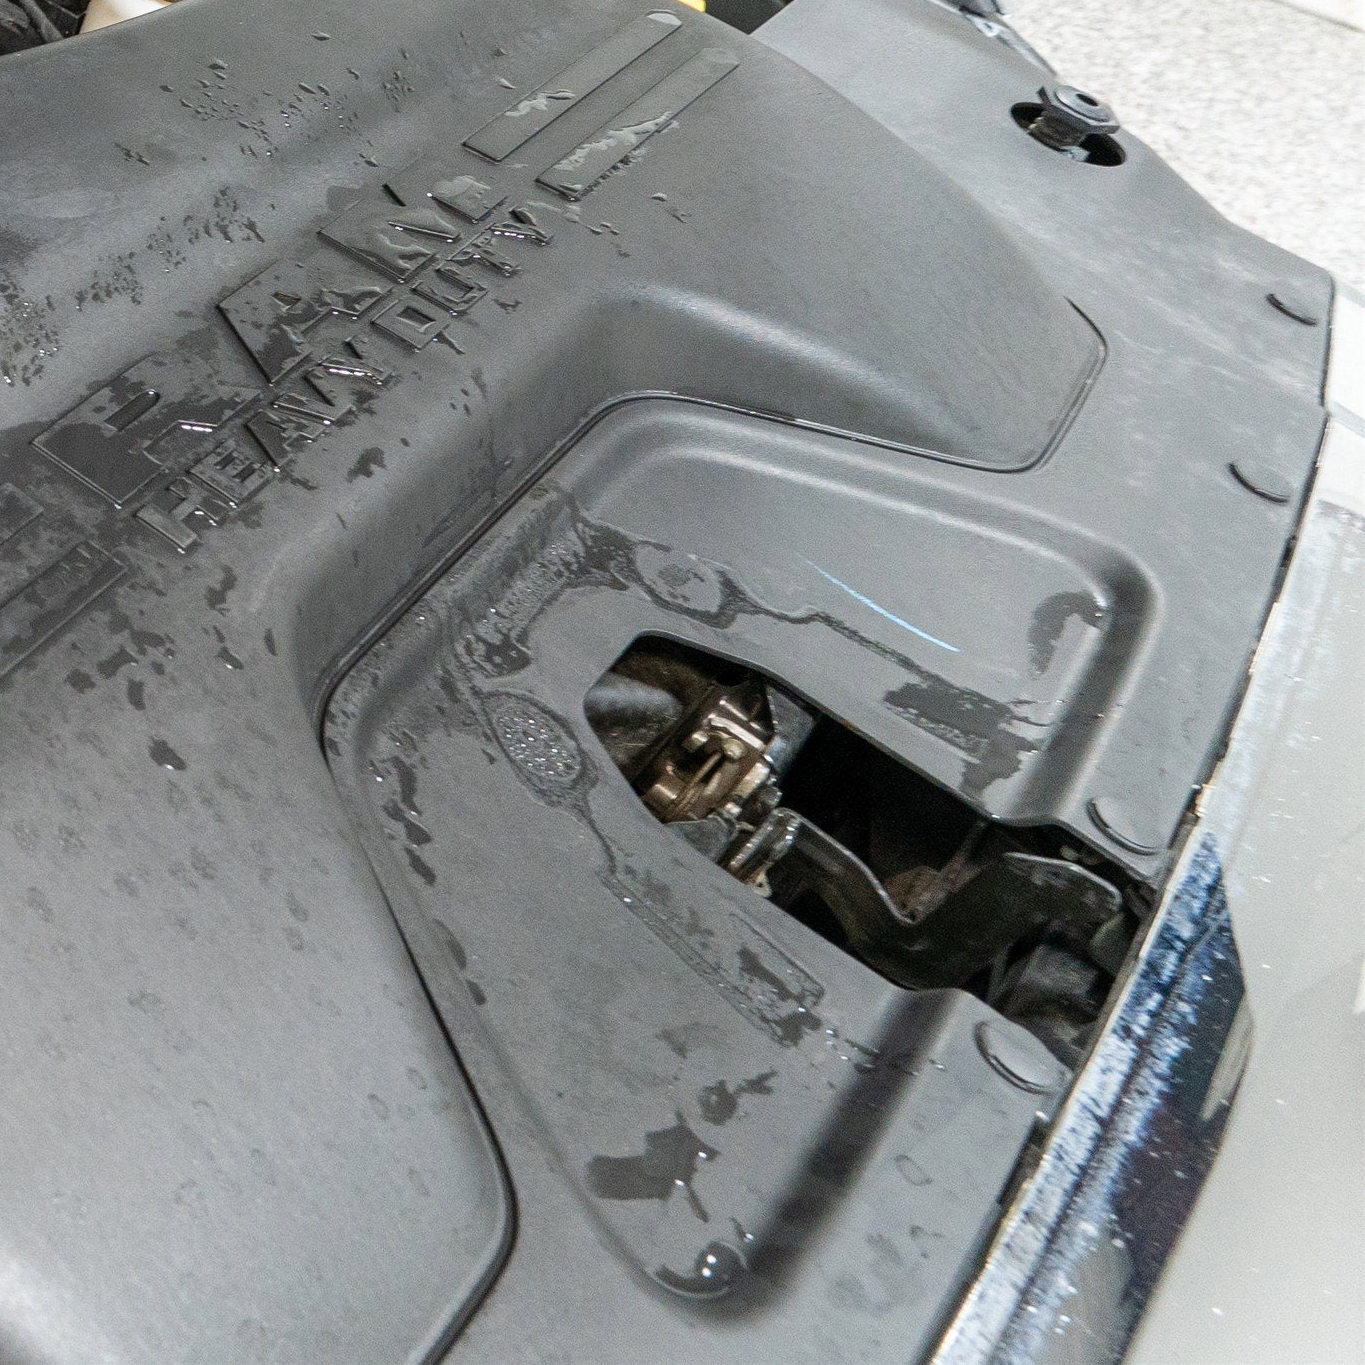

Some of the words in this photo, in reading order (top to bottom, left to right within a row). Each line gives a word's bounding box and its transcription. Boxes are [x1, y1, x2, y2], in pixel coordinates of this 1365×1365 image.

[30, 152, 509, 509] RAM
[135, 337, 399, 554] HEAVY
[371, 205, 553, 353] DUTY
